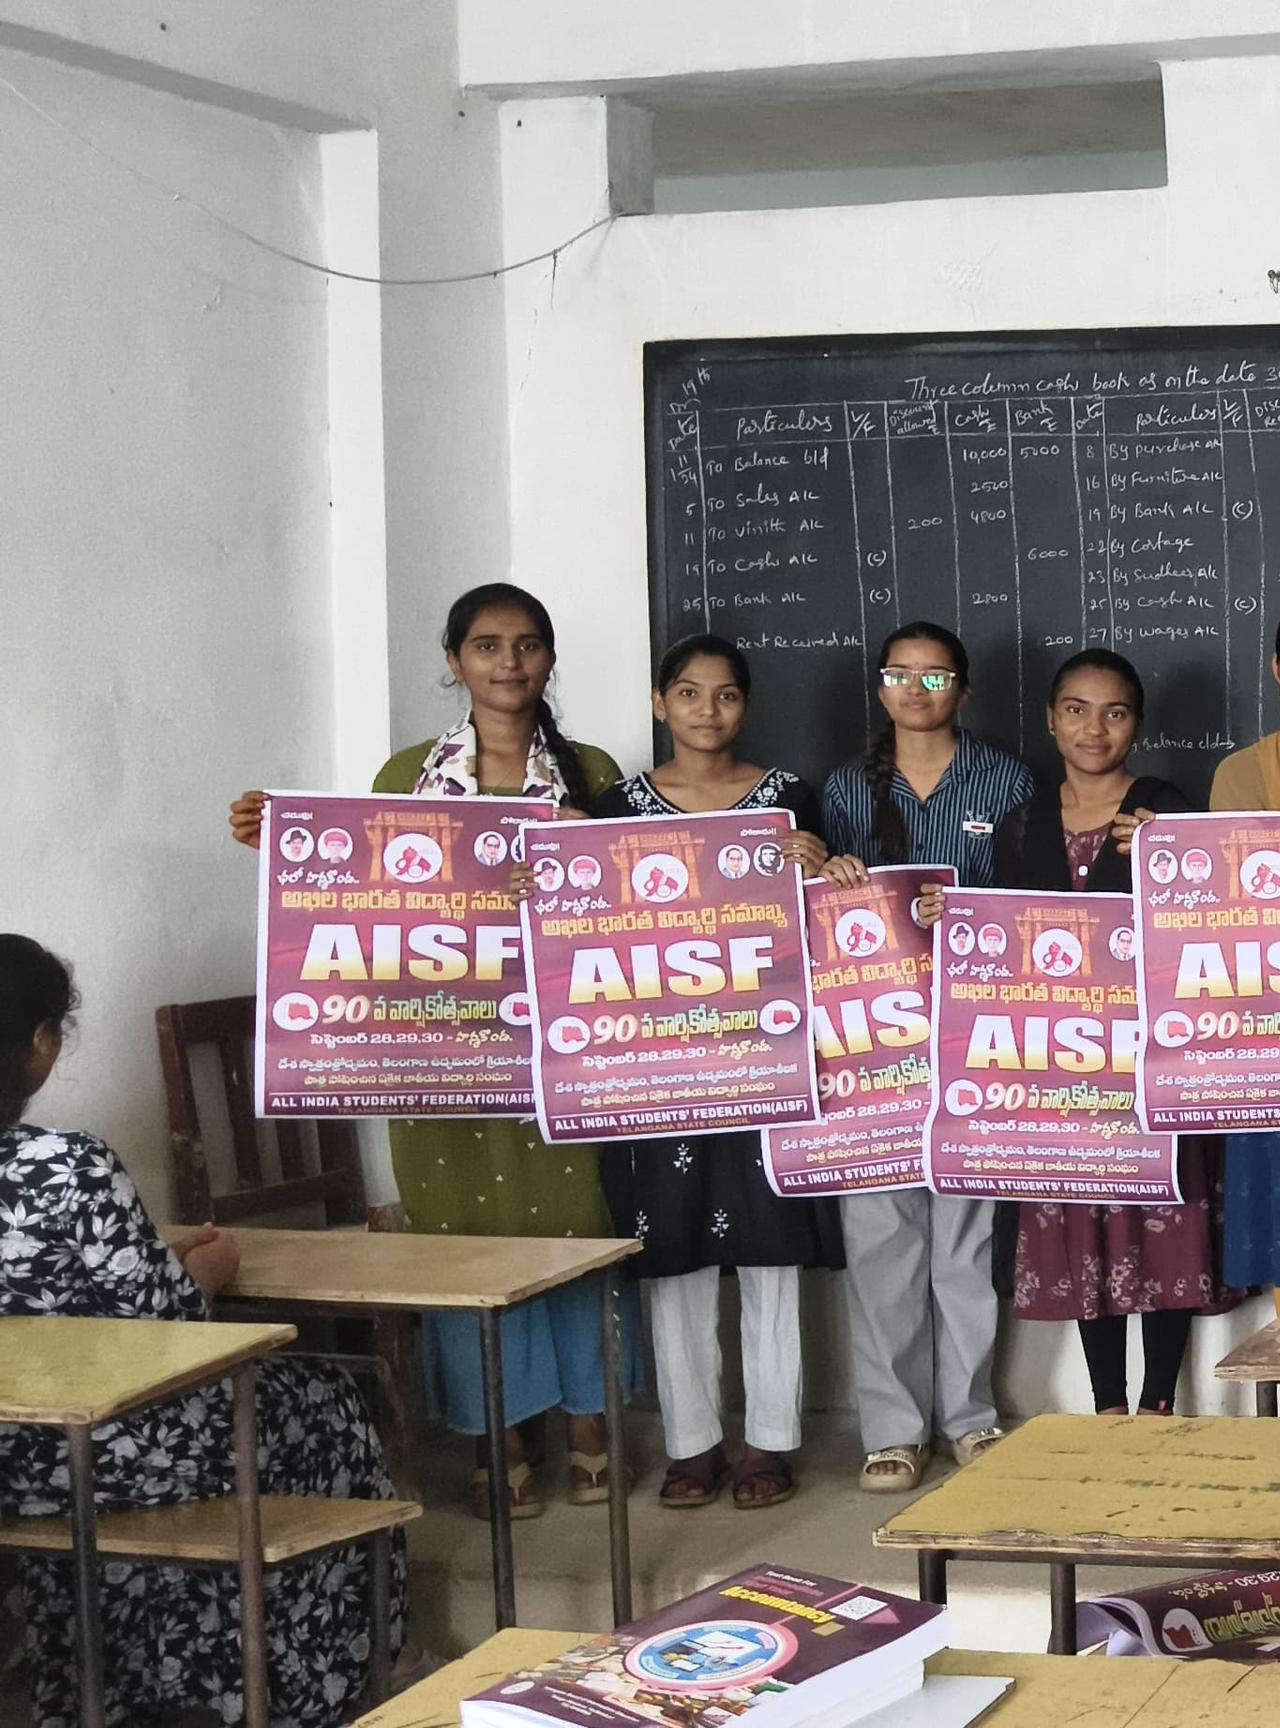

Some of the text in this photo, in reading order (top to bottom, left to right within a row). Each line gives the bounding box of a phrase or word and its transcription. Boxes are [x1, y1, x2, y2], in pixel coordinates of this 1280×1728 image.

[598, 911, 654, 937] భారత
[300, 924, 521, 981] AISF
[569, 936, 774, 1004] AISF
[322, 995, 370, 1024] 90
[813, 990, 930, 1059] AIS
[593, 1014, 639, 1044] 90
[1197, 1011, 1239, 1041] 90
[819, 1069, 856, 1099] 90
[984, 1083, 1025, 1111] 90
